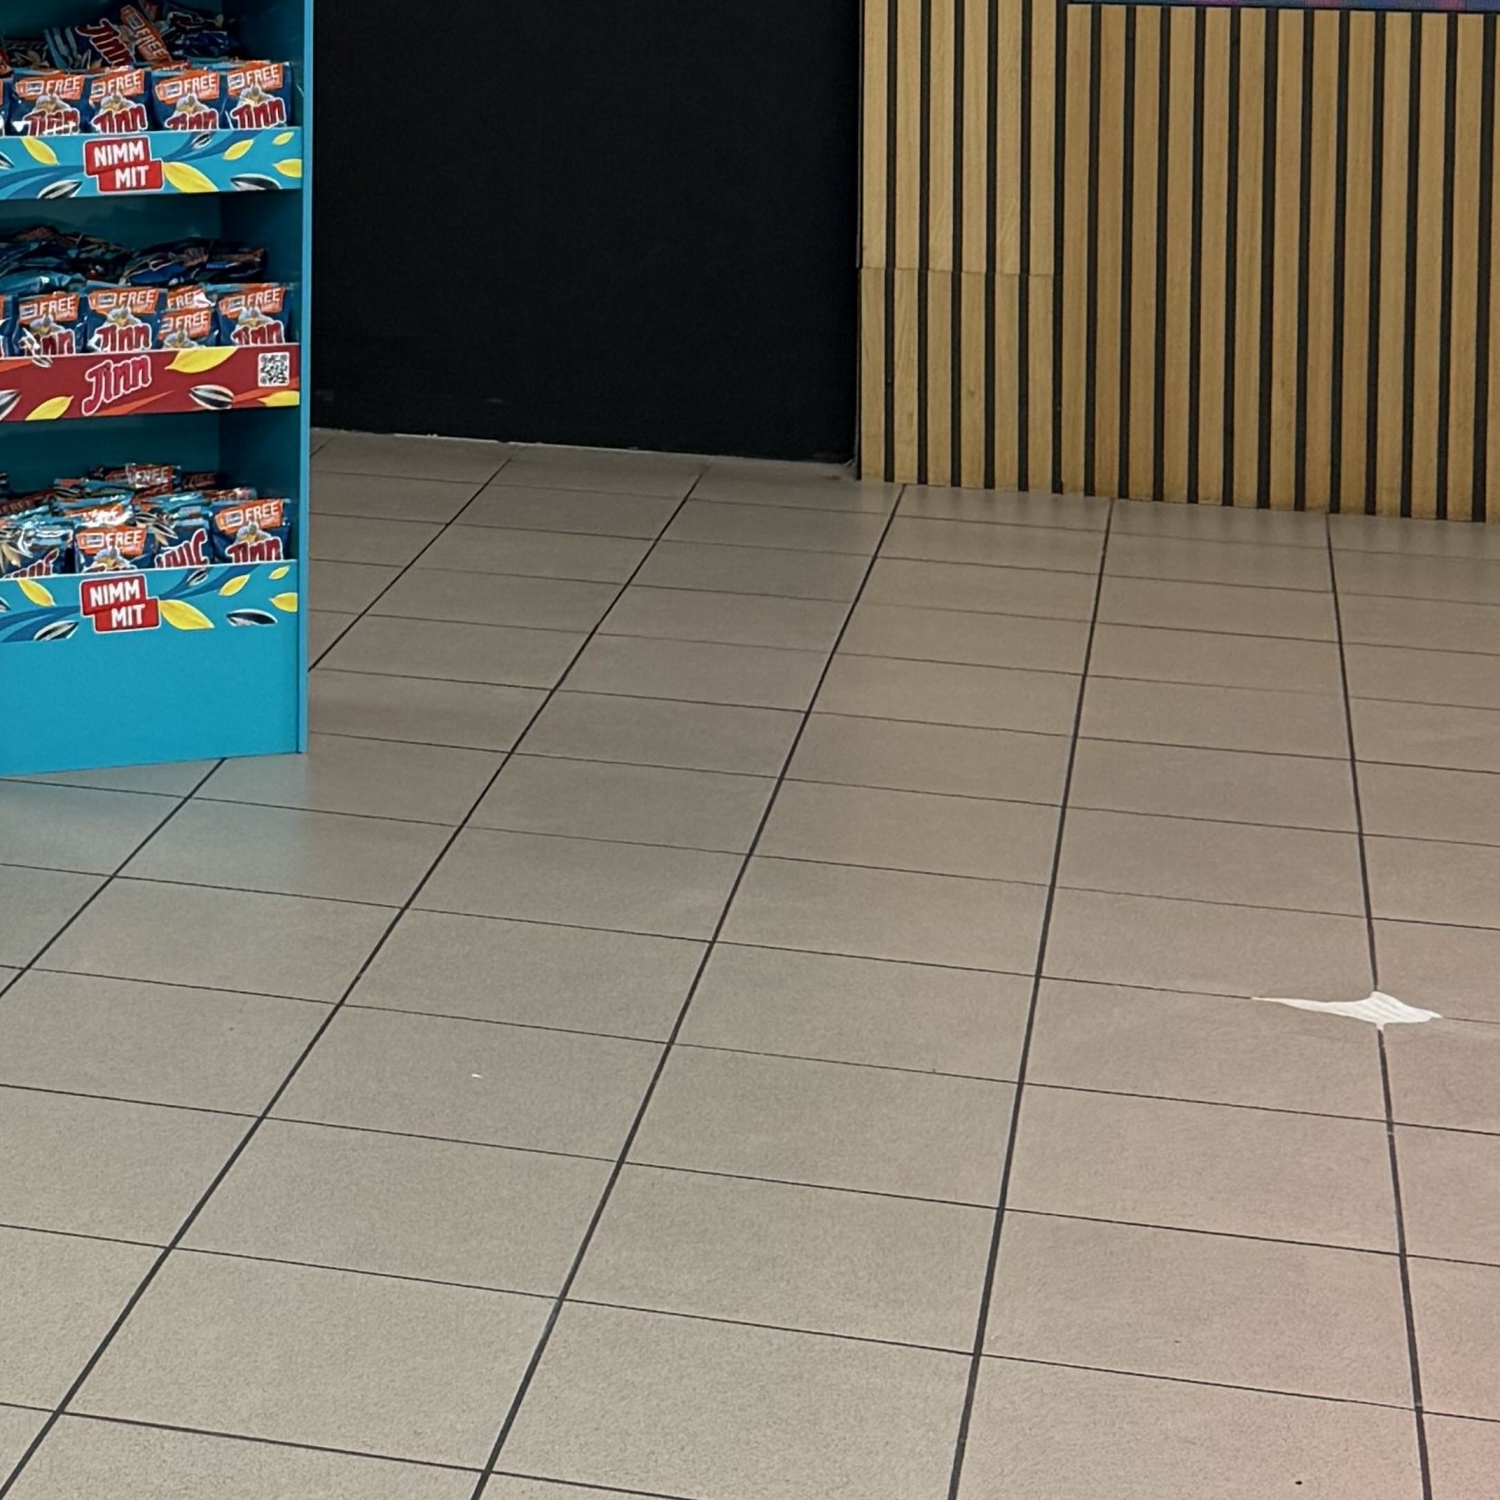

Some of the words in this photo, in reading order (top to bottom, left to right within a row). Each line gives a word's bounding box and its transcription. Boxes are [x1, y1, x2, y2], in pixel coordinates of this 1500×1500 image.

[46, 76, 81, 95] FREE
[108, 72, 141, 92] FREE
[184, 75, 217, 94] FREE
[246, 65, 280, 86] FREE
[94, 137, 145, 165] NIMM
[115, 166, 149, 190] MIT
[118, 289, 154, 305] FREE
[247, 287, 281, 304] FREE
[40, 296, 76, 317] FREE
[175, 312, 209, 330] FREE
[81, 355, 152, 416] Jinn
[246, 503, 281, 521] FREE
[106, 532, 142, 548] FREE
[90, 579, 140, 607] NIMM
[111, 605, 146, 629] MIT
